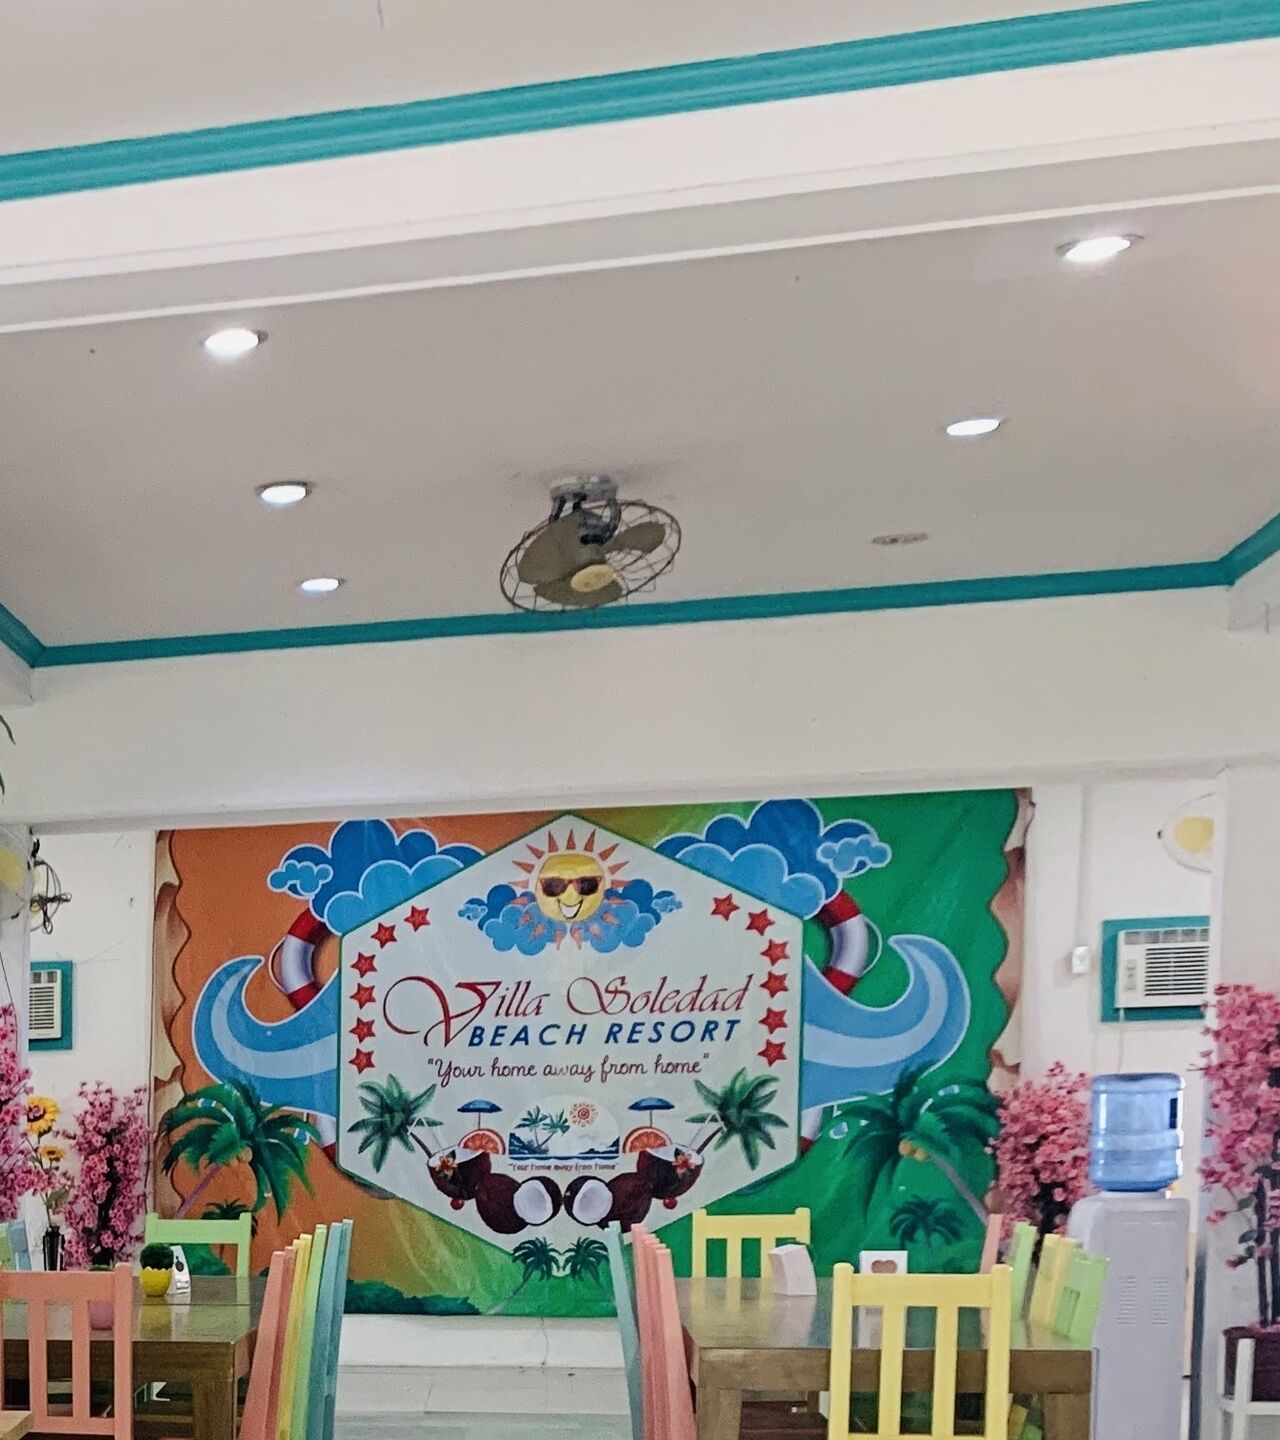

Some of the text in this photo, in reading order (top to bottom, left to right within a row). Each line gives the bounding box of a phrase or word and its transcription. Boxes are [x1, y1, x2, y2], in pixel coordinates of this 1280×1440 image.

[382, 972, 754, 1048] Villa Soledad
[467, 1018, 741, 1048] BEACH RESORT
[427, 1053, 709, 1088] "Your home away from home"
